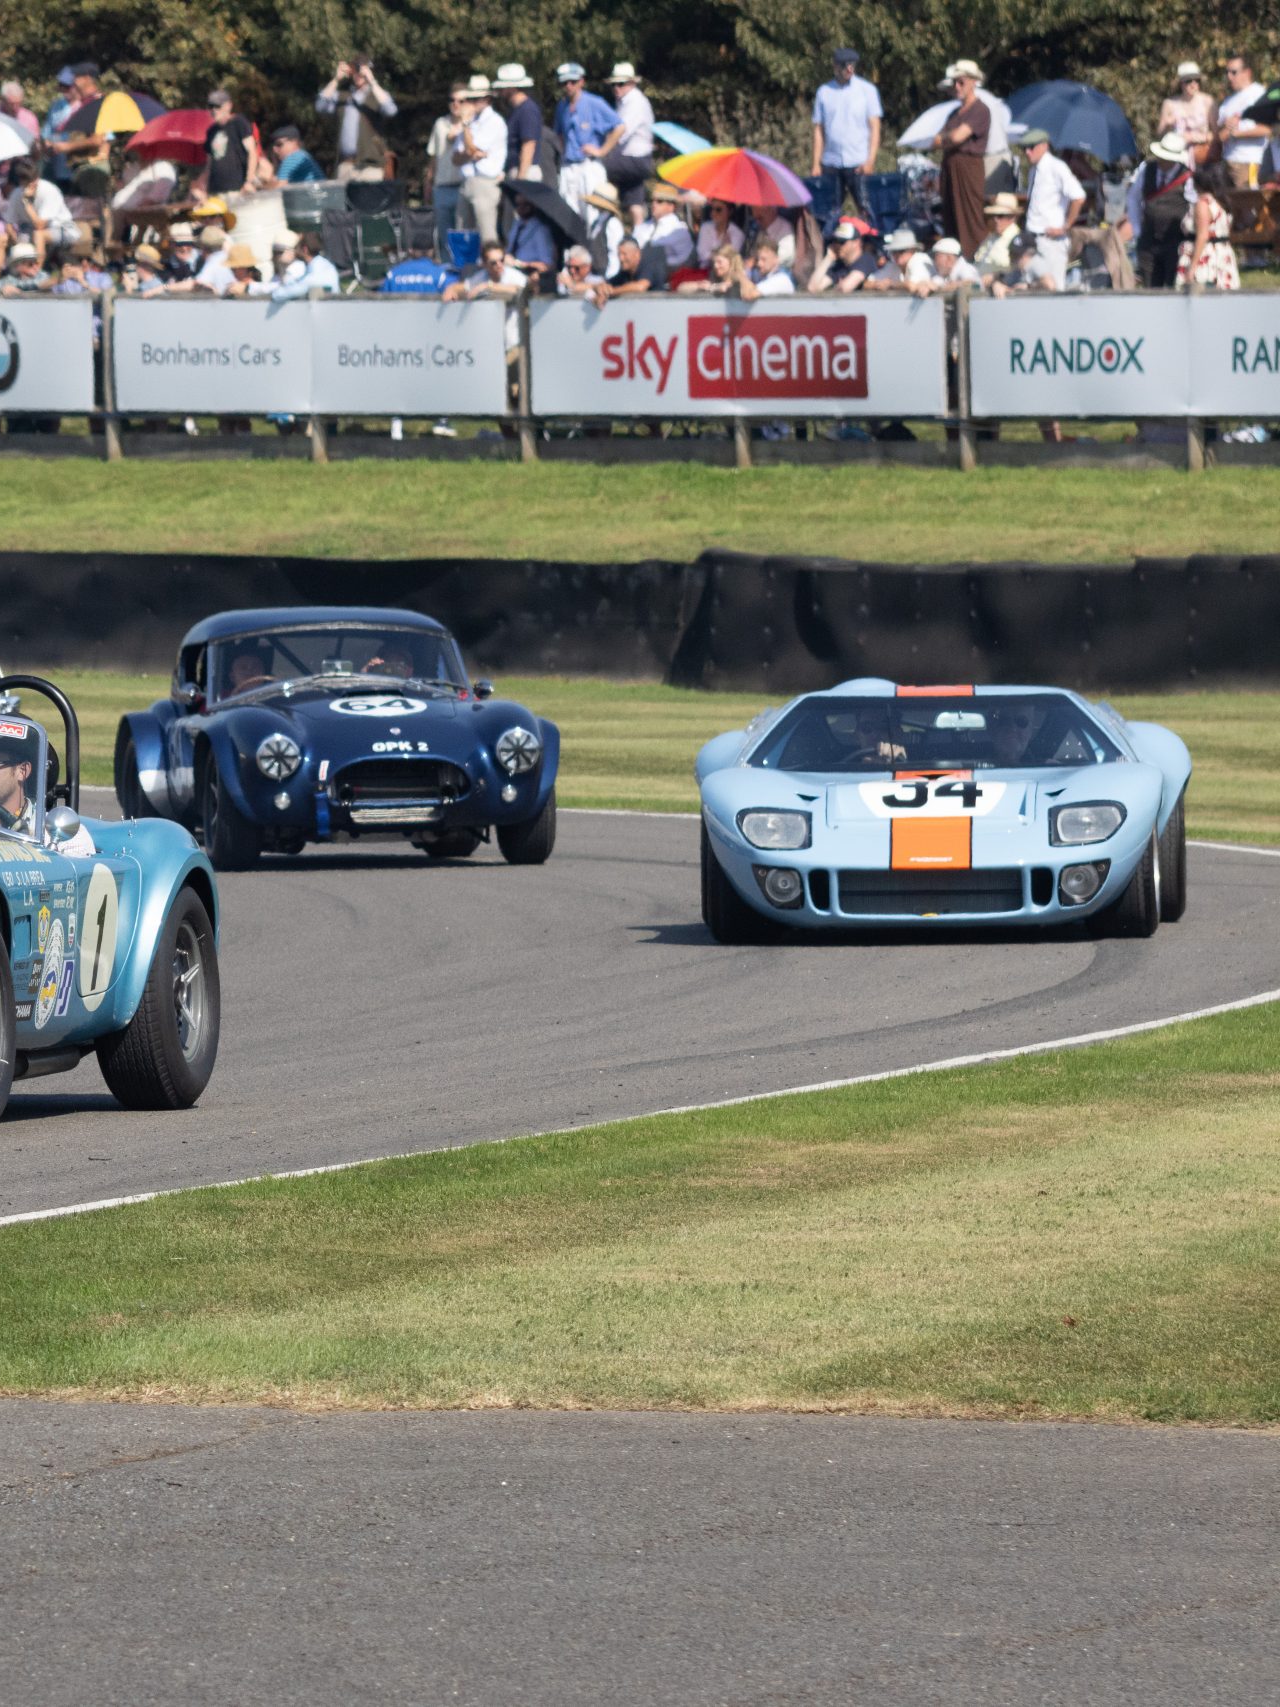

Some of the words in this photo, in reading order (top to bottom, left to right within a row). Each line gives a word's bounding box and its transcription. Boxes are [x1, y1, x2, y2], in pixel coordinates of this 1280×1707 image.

[141, 342, 231, 366] Bonhams
[238, 343, 282, 366] Cars
[338, 344, 424, 368] Bonhams
[431, 345, 476, 368] Cars
[600, 320, 678, 396] sky
[696, 323, 858, 381] cinema
[1009, 337, 1145, 374] RANDOX
[1231, 336, 1280, 373] RA
[339, 699, 415, 711] 64
[882, 781, 983, 808] 34
[90, 893, 108, 992] 1
